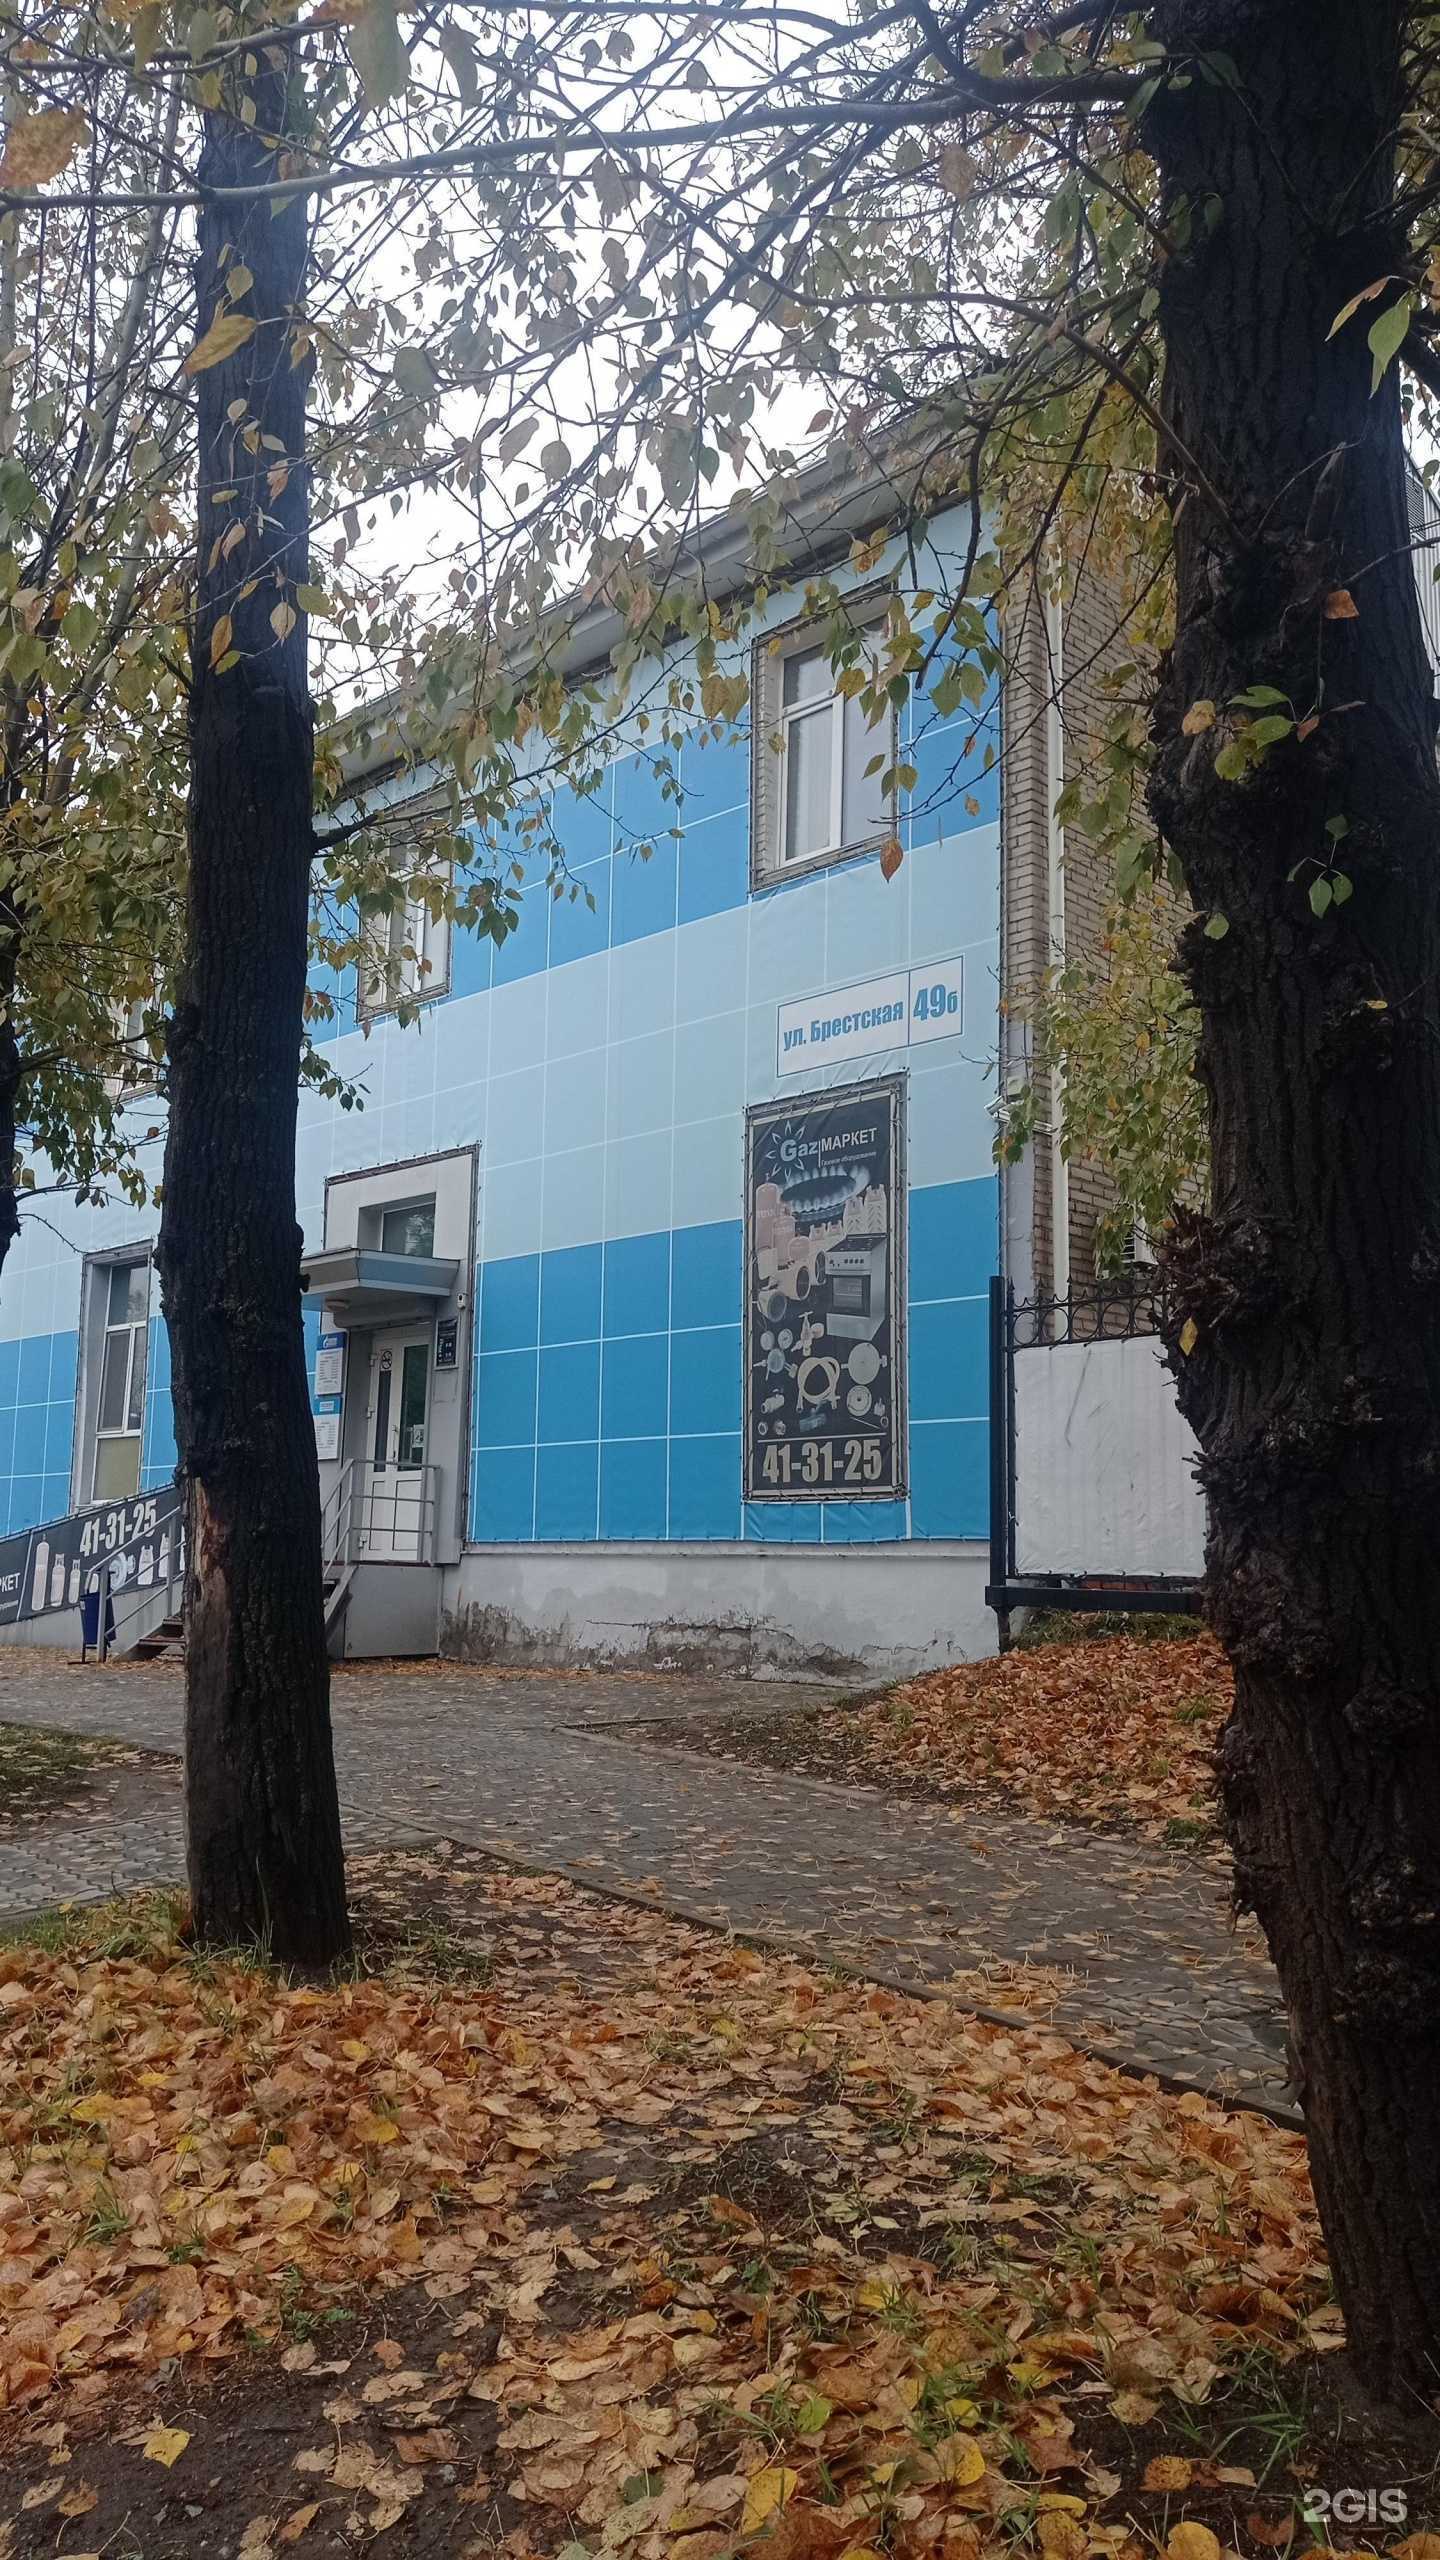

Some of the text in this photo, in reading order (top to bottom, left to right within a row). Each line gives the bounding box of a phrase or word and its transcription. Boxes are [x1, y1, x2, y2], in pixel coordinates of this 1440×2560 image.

[783, 984, 958, 1051] ул. Брестская 49б
[821, 1127, 877, 1152] МАРКЕТ
[762, 1438, 882, 1483] 41-31-25
[79, 1499, 157, 1557] 41-31-25
